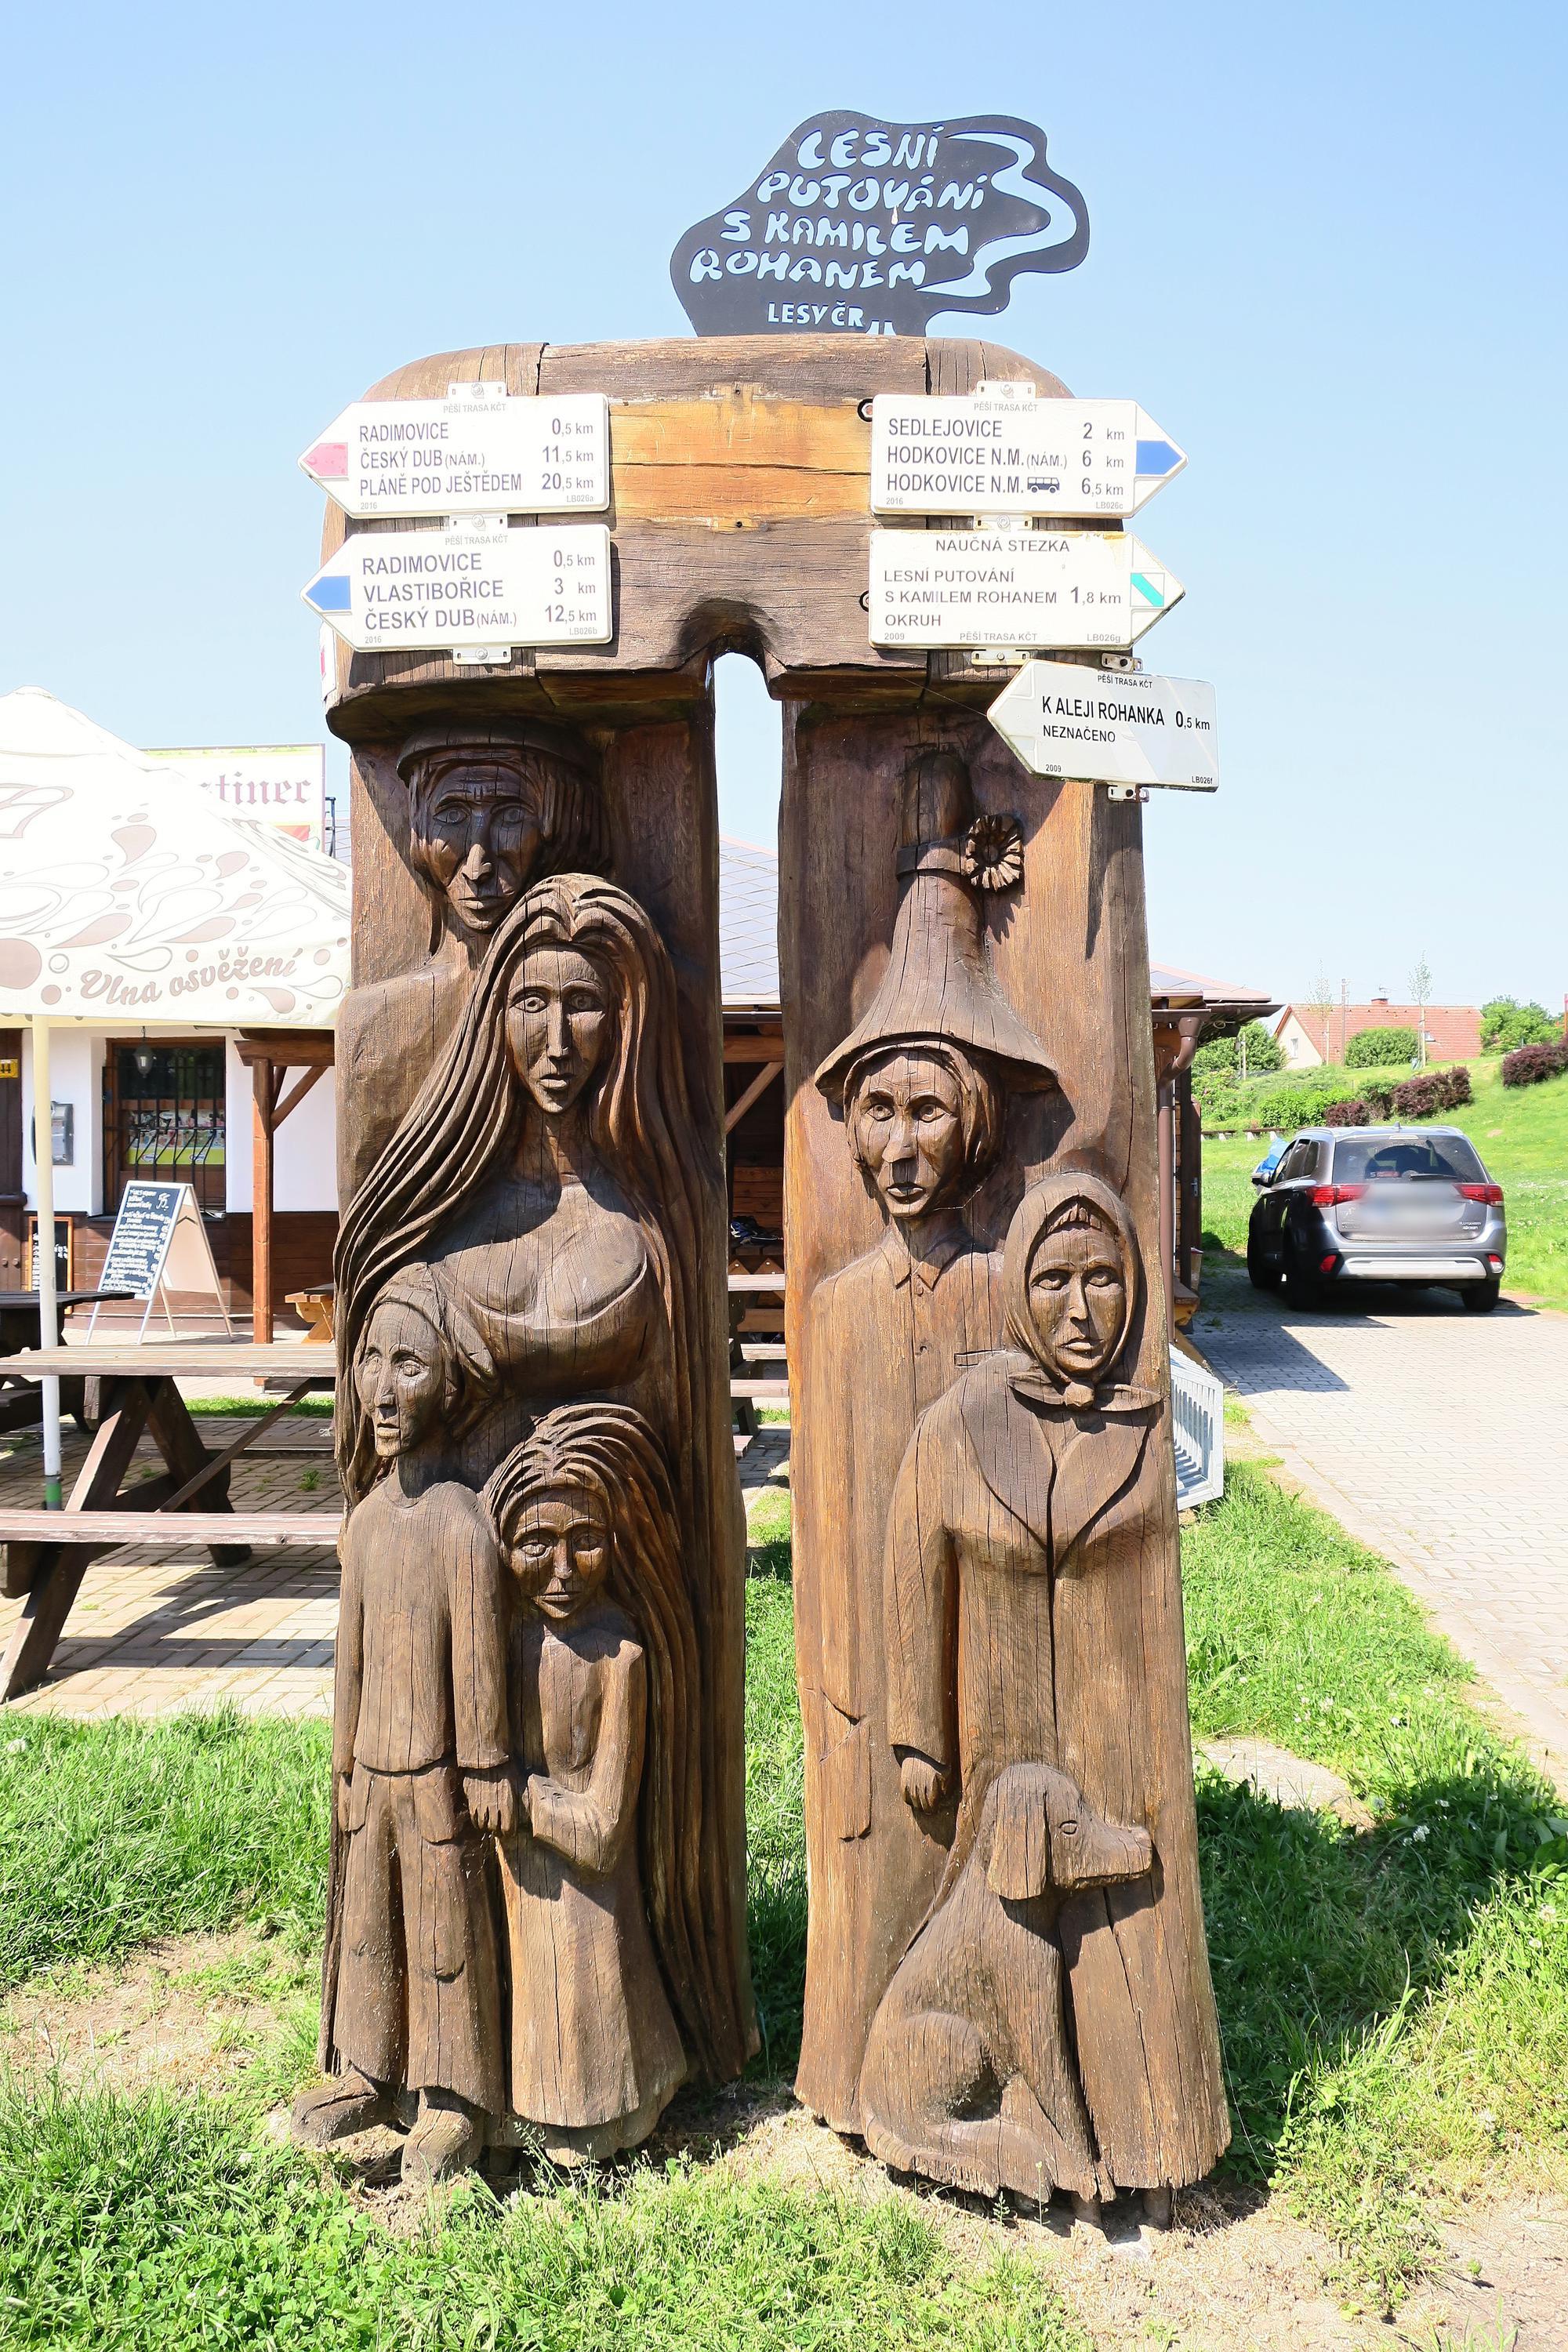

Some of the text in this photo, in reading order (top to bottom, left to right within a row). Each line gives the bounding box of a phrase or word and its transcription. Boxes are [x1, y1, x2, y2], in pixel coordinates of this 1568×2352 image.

[757, 170, 988, 212] PUTOVÁNÍ
[720, 209, 969, 256] S KAMILEM
[689, 249, 926, 289] ROHANEM
[768, 300, 864, 327] LESY ČR
[443, 402, 506, 414] PĚŠÍ TRASA KČT
[974, 402, 1038, 412] PĚŠÍ TRASA KČT
[360, 418, 593, 442] RADIMOVICE 0,5 km
[889, 418, 1124, 440] SEDLEJOVICE 2 km
[361, 445, 593, 470] ČESKÝ DUB (NÁM.) 11,5 km
[887, 445, 1124, 469] HODKOVICE N.M. (NÁM.) 6 km
[361, 471, 593, 496] PLÁNĚ POD JEŠTĚDEM 20,5 km
[887, 474, 1123, 497] HODKOVICE N.M. 6,5 km
[566, 494, 594, 503] LB026a
[886, 497, 1123, 510] 2016 LB026c
[445, 534, 508, 545] PĚŠÍ TRASA KČT
[936, 536, 1069, 552] NAUČNÁ STEZKA
[362, 550, 595, 575] RADIMOVICE 0,5 km
[884, 568, 1014, 583] LESNÍ PUTOVÁNÍ
[364, 577, 596, 603] VLASTIBOŘICE 3 km
[885, 586, 1121, 606] S KAMILEM ROHANEM 1,8 km
[365, 604, 597, 630] ČESKÝ DUB (NÁM.) 12,5 km
[885, 614, 941, 626] OKRUH
[365, 635, 382, 644] 2016
[960, 632, 982, 641] PĚŠÍ
[983, 633, 1016, 641] TRASA
[1018, 632, 1037, 641] KČT
[1087, 634, 1120, 644] LB026g
[1098, 674, 1152, 688] PĚŠÍ TRASA KČT
[1042, 696, 1210, 730] K ALEJI ROHANKA 0,5 km
[1043, 724, 1116, 742] NEZNAČENO
[81, 946, 303, 1005] Vlna osvěžení
